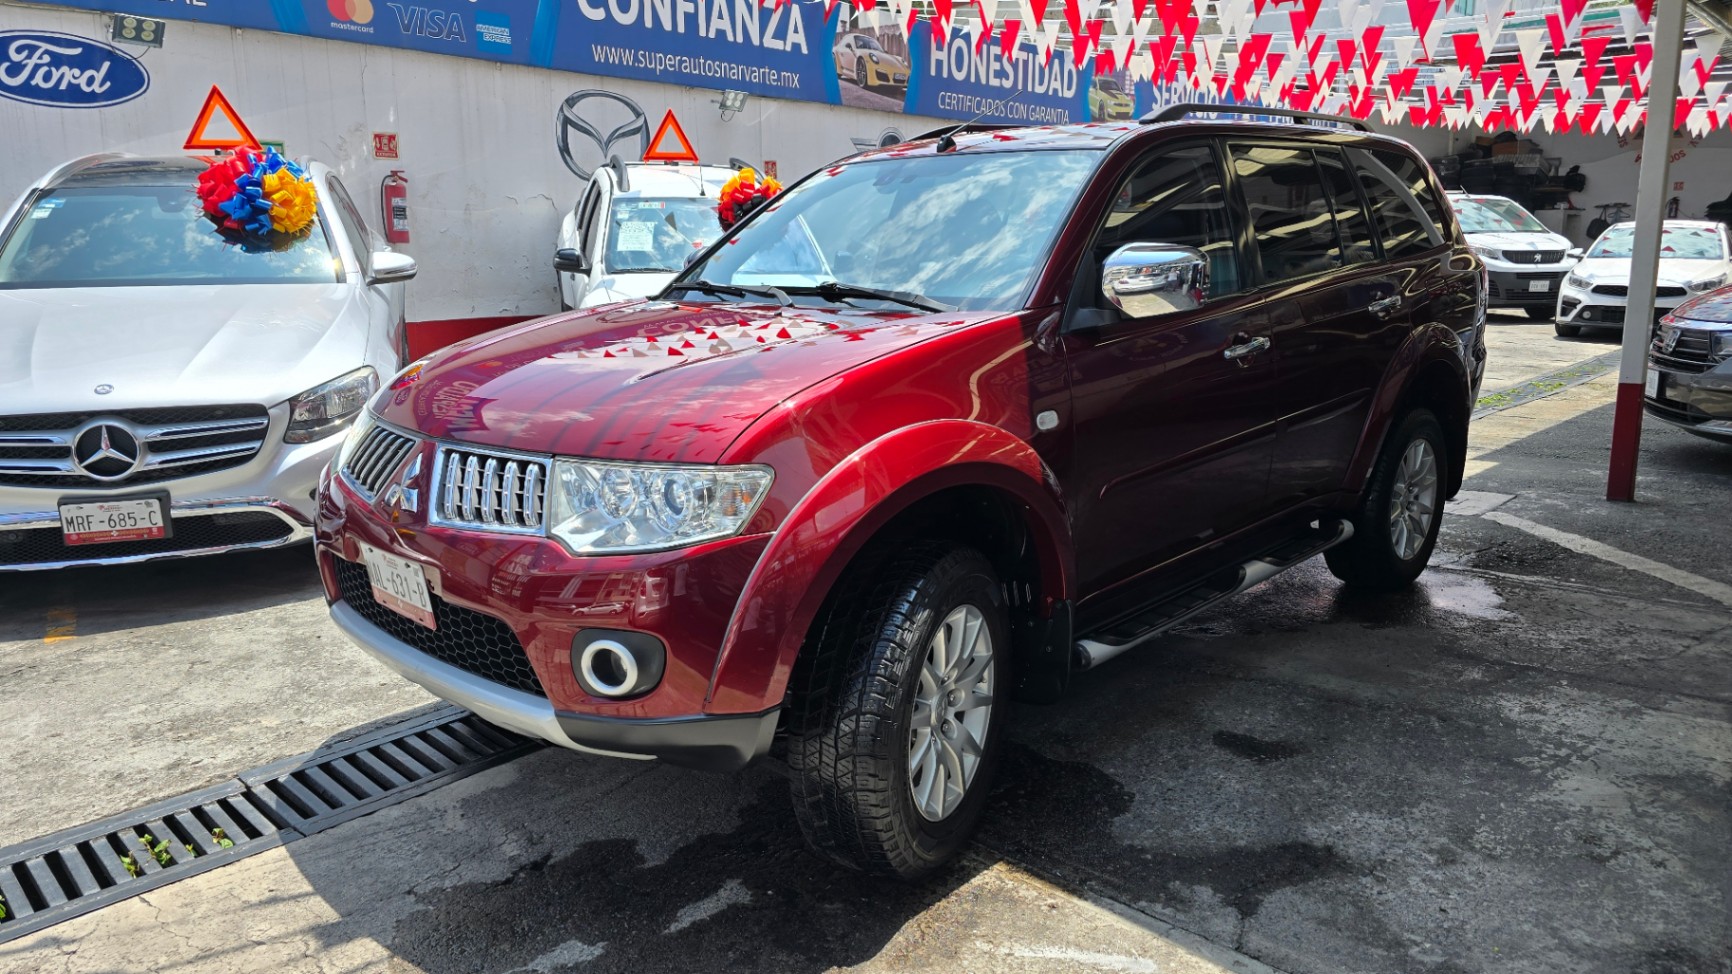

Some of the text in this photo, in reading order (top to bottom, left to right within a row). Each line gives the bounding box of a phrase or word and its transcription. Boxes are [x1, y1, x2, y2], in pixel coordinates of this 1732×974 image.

[330, 21, 375, 34] mastercard
[386, 2, 467, 43] VISA
[483, 32, 511, 44] EXPRESS
[0, 39, 111, 94] Ford
[591, 43, 801, 89] www.superautosnarvarte.mx
[930, 33, 1078, 98] HONESTIDAD
[937, 91, 1006, 118] CERTIFICADOS
[1007, 100, 1028, 120] CON
[64, 510, 158, 533] MRF-685-C
